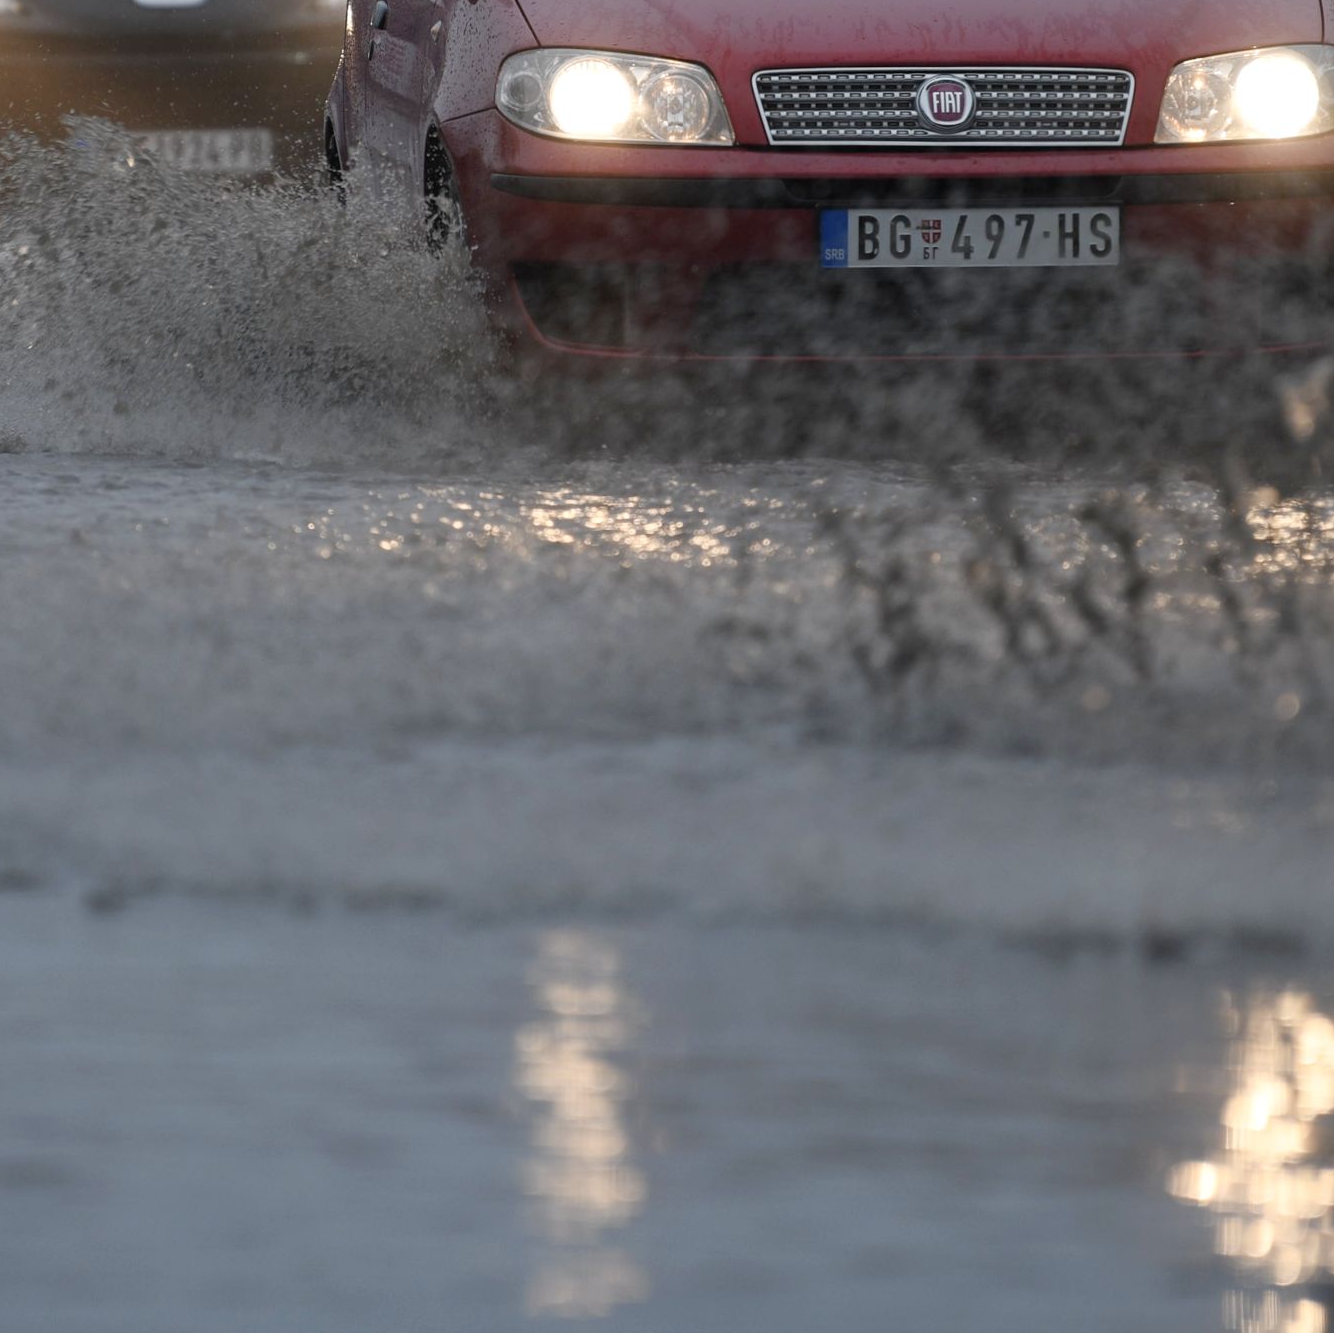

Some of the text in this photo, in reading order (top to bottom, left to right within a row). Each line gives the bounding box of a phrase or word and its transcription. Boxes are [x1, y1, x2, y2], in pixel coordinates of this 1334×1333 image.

[932, 91, 963, 114] FIAT
[857, 214, 912, 261] BG
[824, 248, 845, 260] SRB
